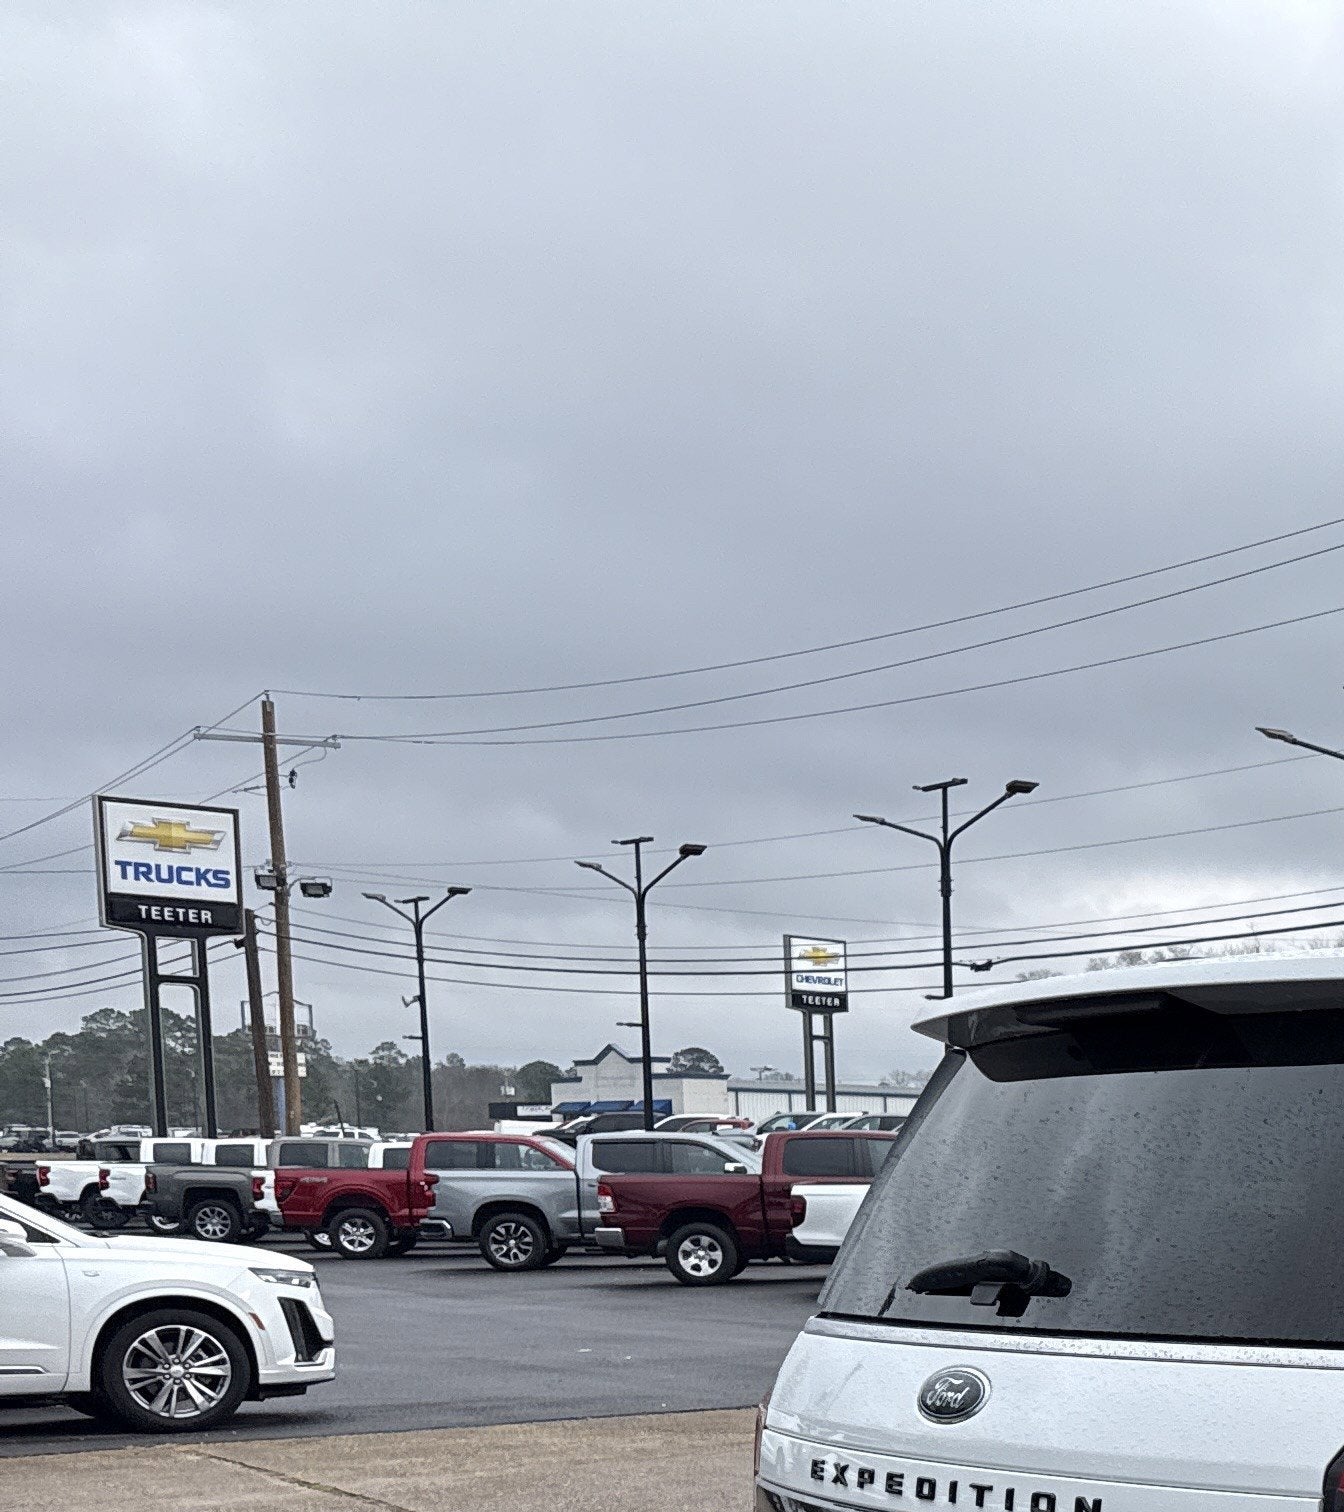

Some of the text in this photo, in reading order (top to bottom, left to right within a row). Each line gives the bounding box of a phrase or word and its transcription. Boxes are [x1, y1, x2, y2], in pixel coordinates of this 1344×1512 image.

[114, 860, 231, 889] TRUCKS
[138, 904, 213, 924] TEETER
[796, 974, 844, 987] CHEVROLET
[801, 995, 840, 1007] TEETER
[926, 1377, 970, 1408] Ford
